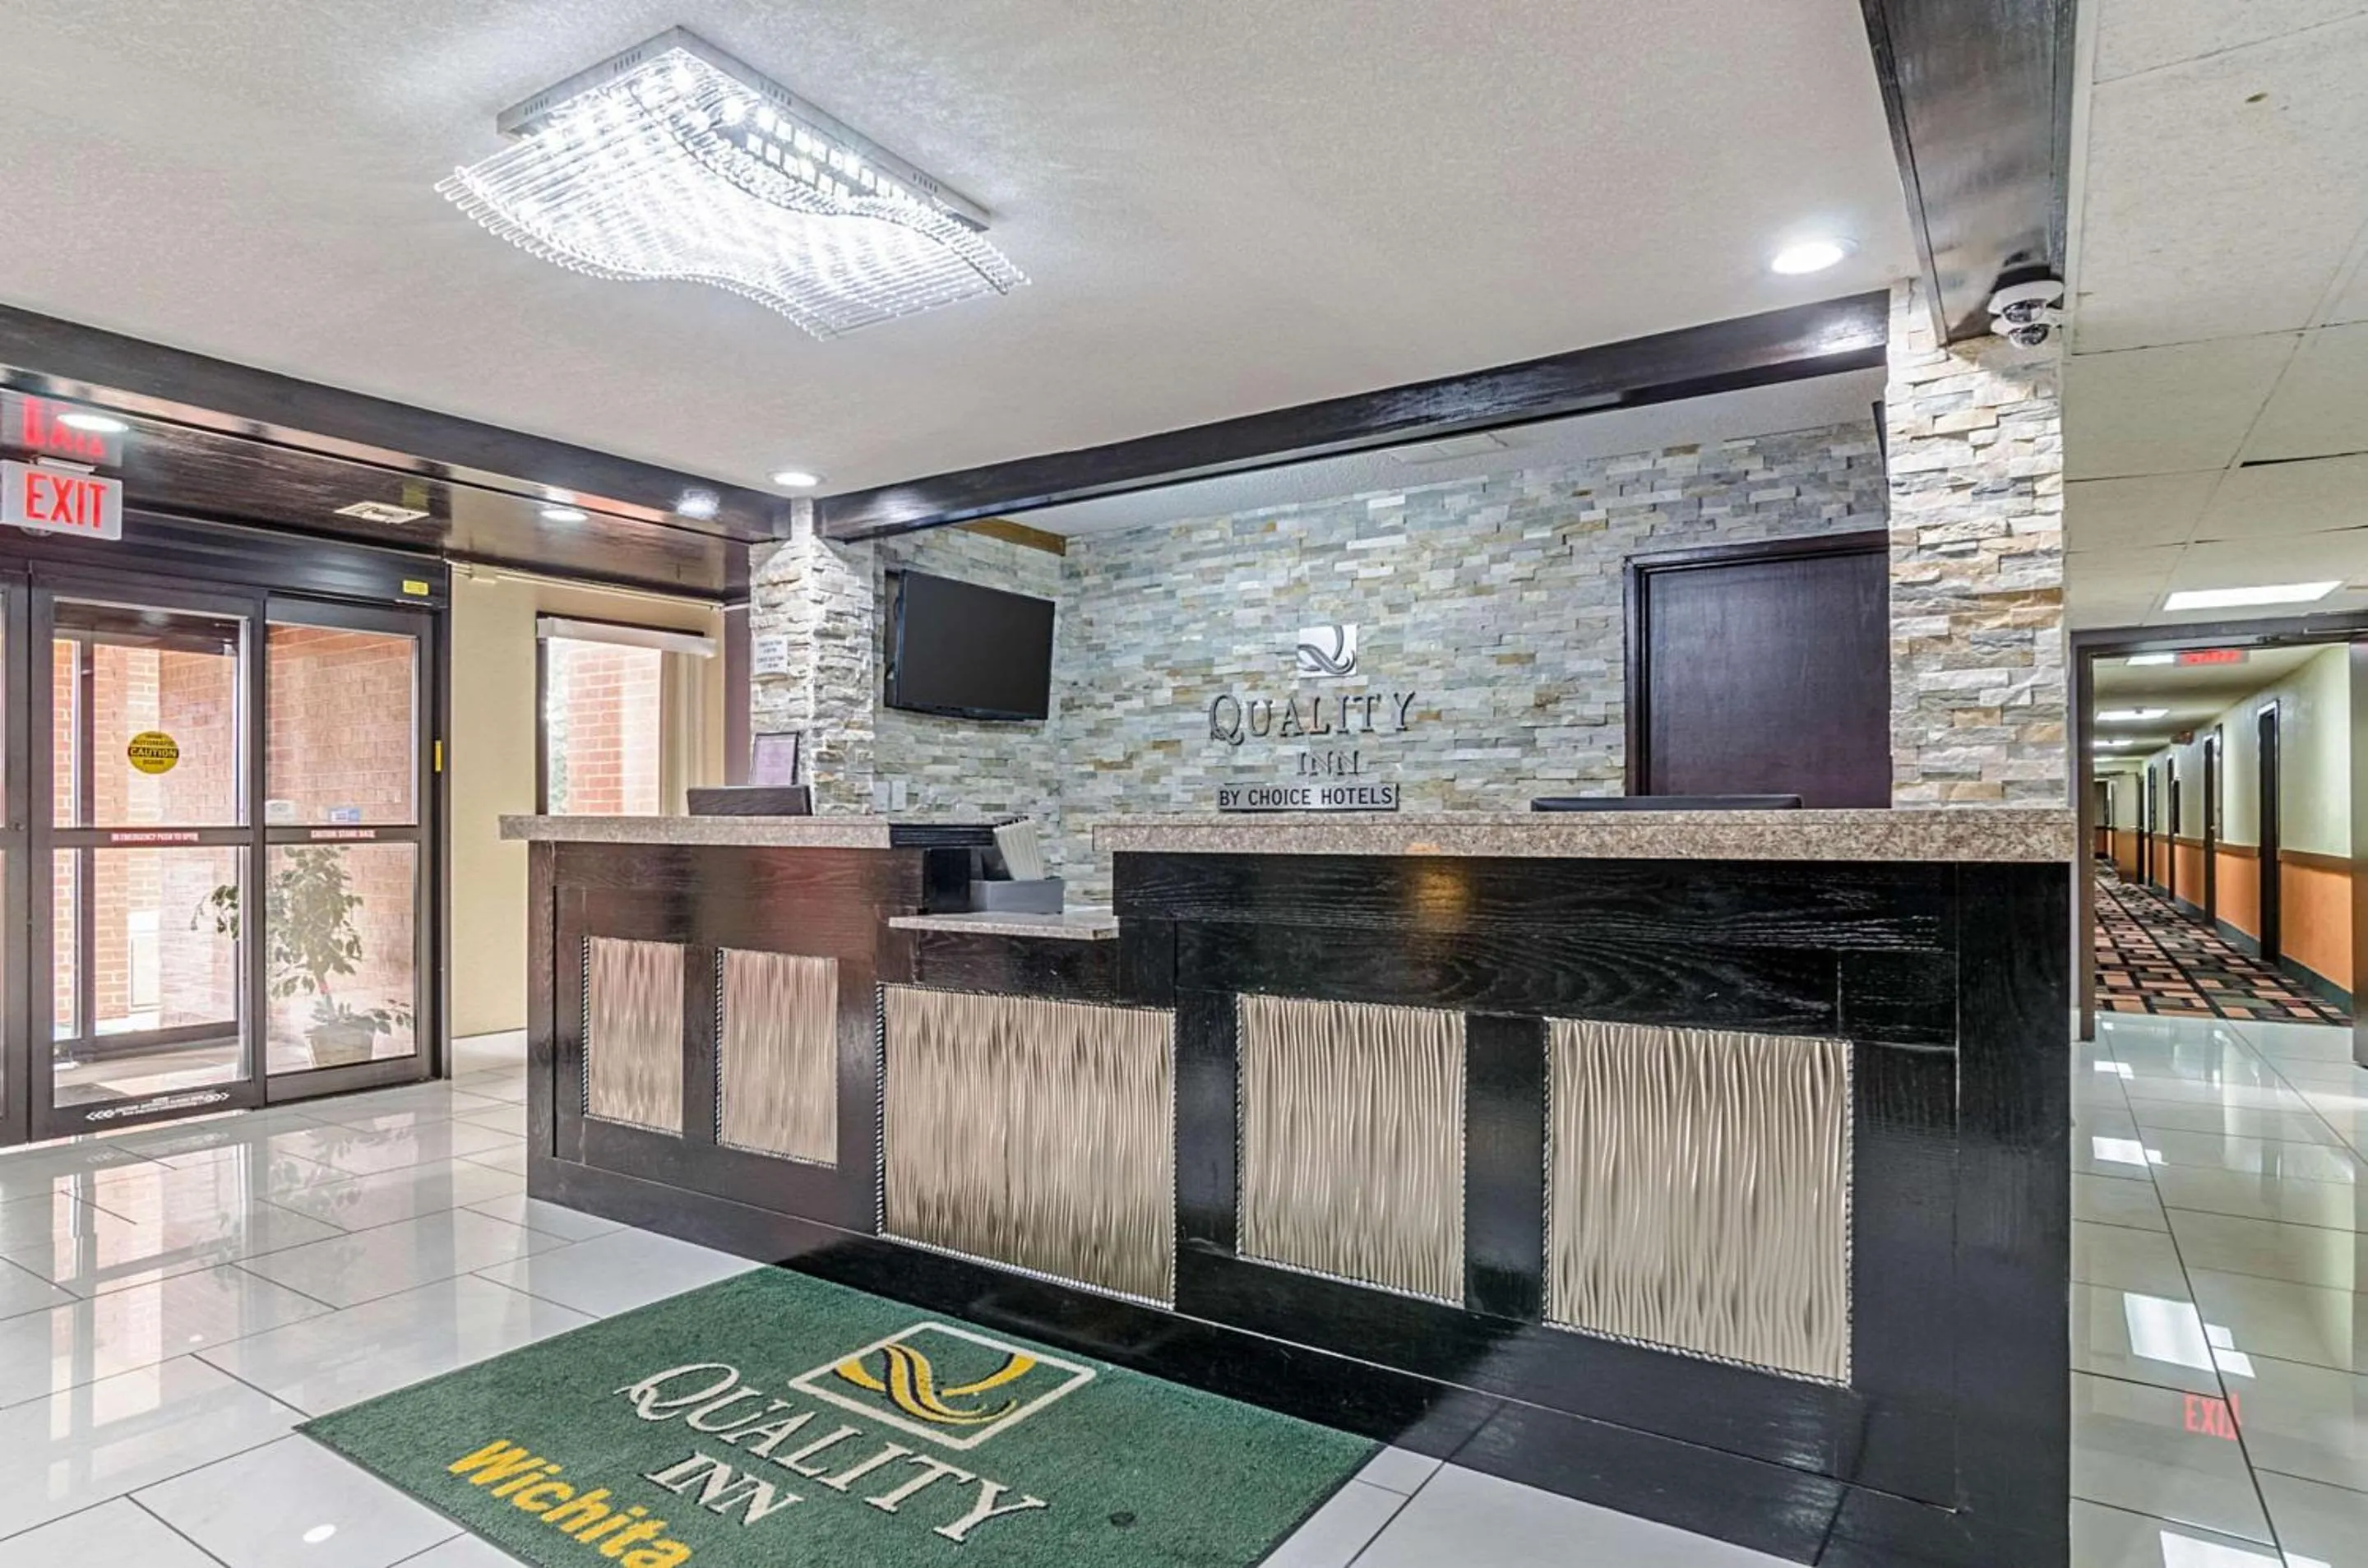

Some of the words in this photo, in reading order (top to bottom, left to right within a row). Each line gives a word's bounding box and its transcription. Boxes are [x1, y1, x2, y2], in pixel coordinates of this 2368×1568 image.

[25, 472, 108, 529] EXIT
[1209, 691, 1416, 746] QUALITY
[131, 747, 177, 757] CAUTION
[1296, 750, 1360, 775] INN
[1219, 789, 1241, 807] BY
[1248, 788, 1311, 806] CHOICE
[1320, 786, 1393, 805] HOTELS
[613, 1362, 1048, 1543] QUALITY
[447, 1439, 692, 1568] Wichita
[644, 1450, 805, 1527] INN
